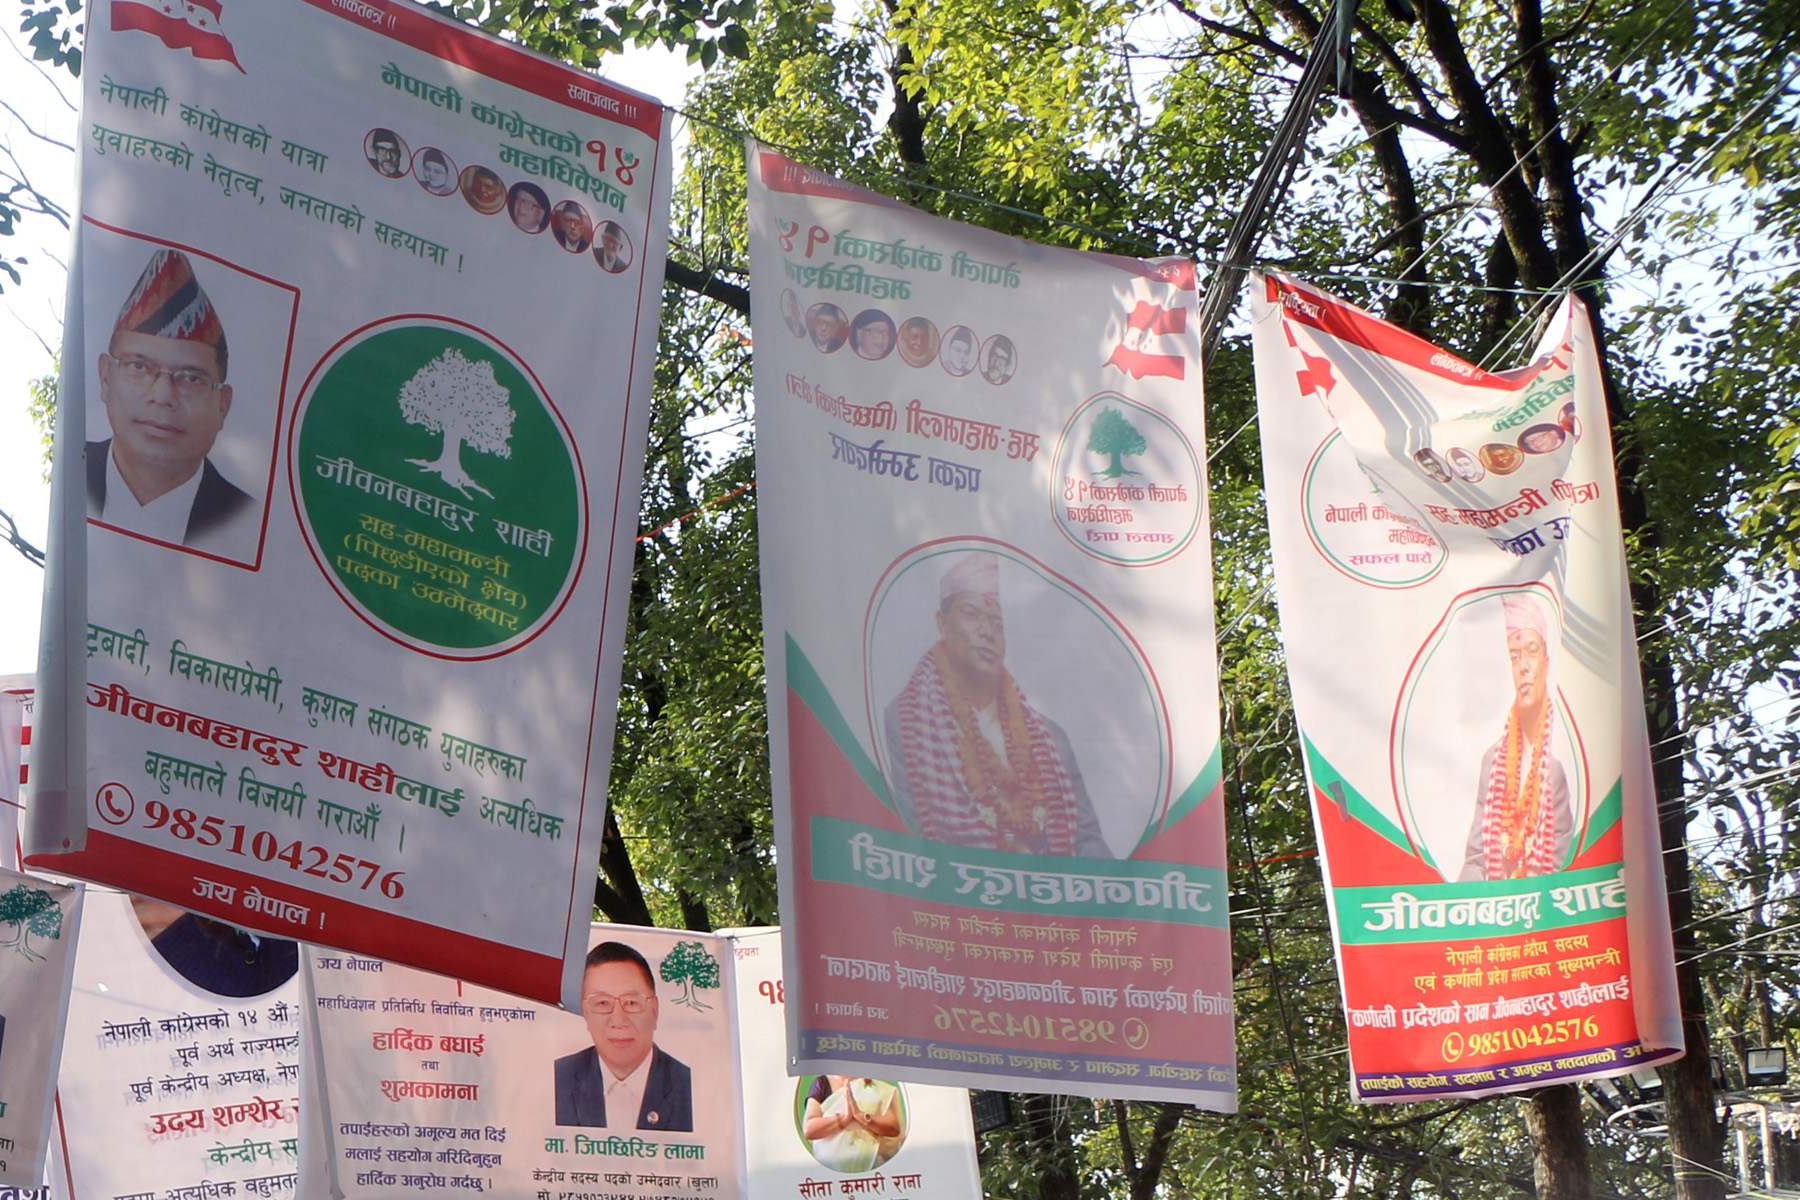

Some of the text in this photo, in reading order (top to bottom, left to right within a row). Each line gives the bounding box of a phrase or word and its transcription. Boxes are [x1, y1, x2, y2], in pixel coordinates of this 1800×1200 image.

[382, 63, 462, 113] नेपाली
[100, 75, 169, 116] नेपाली
[282, 141, 328, 173] यात्रा
[280, 187, 364, 233] जनताको
[316, 455, 554, 557] जीवनबहादुर शाही
[336, 555, 400, 589] पदका
[87, 683, 308, 767] जीवनबहादुर
[301, 688, 358, 728] कुशल
[144, 801, 406, 900] 9851042576
[192, 877, 309, 925] जय नेपाल
[1362, 891, 1541, 931] जीवनबहादुर
[318, 956, 383, 972] जय नेपाल
[1446, 948, 1481, 966] नेपाली
[102, 1010, 256, 1039] नेपाली १४
[1468, 1015, 1599, 1058] 9851042576
[373, 1029, 485, 1057] हार्दिक बधाई
[421, 1060, 439, 1071] तथा
[381, 1078, 478, 1102] शुभकामना
[150, 1109, 205, 1134] उदय
[460, 1127, 480, 1141] मत
[663, 1141, 705, 1160] लामा
[799, 1172, 922, 1200] सीता कुमारी राना
